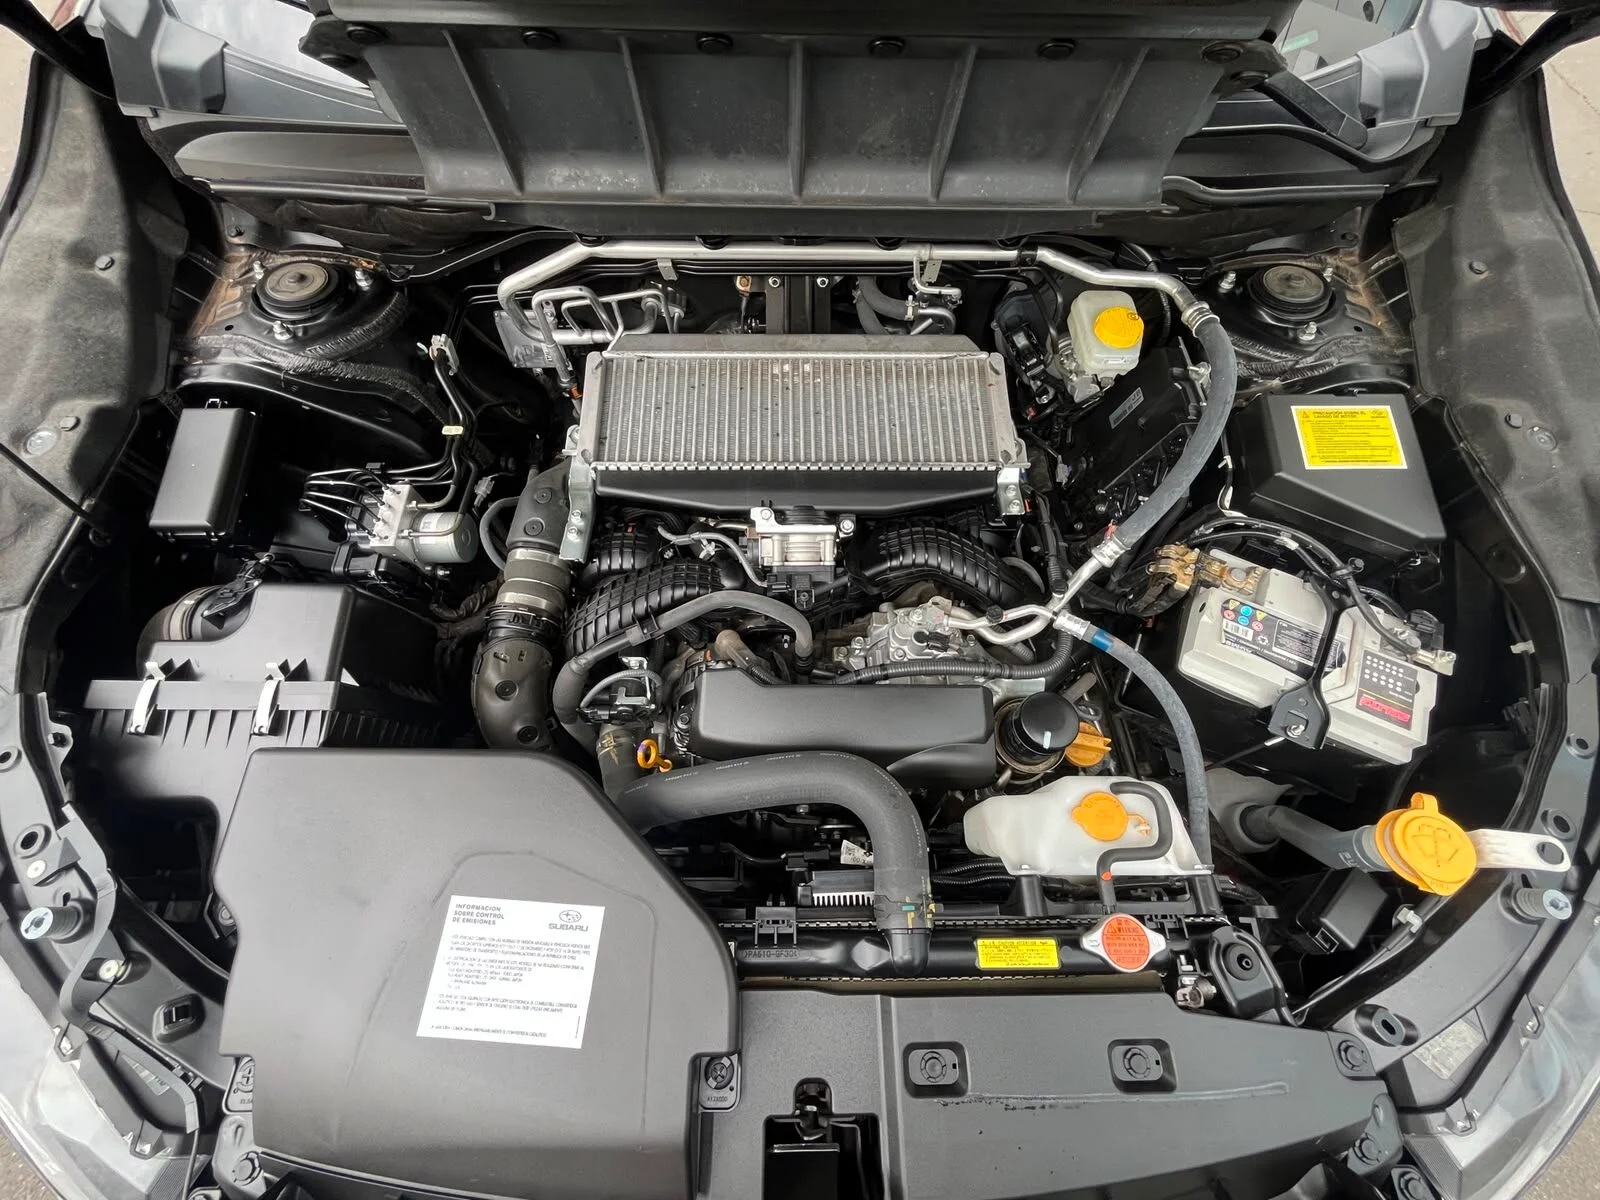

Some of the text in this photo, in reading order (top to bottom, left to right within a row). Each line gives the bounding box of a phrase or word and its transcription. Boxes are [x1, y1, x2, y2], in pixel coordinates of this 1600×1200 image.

[453, 909, 505, 920] SOBRE CONTROL
[461, 917, 497, 926] EMISIONES
[548, 922, 589, 932] SUBARU
